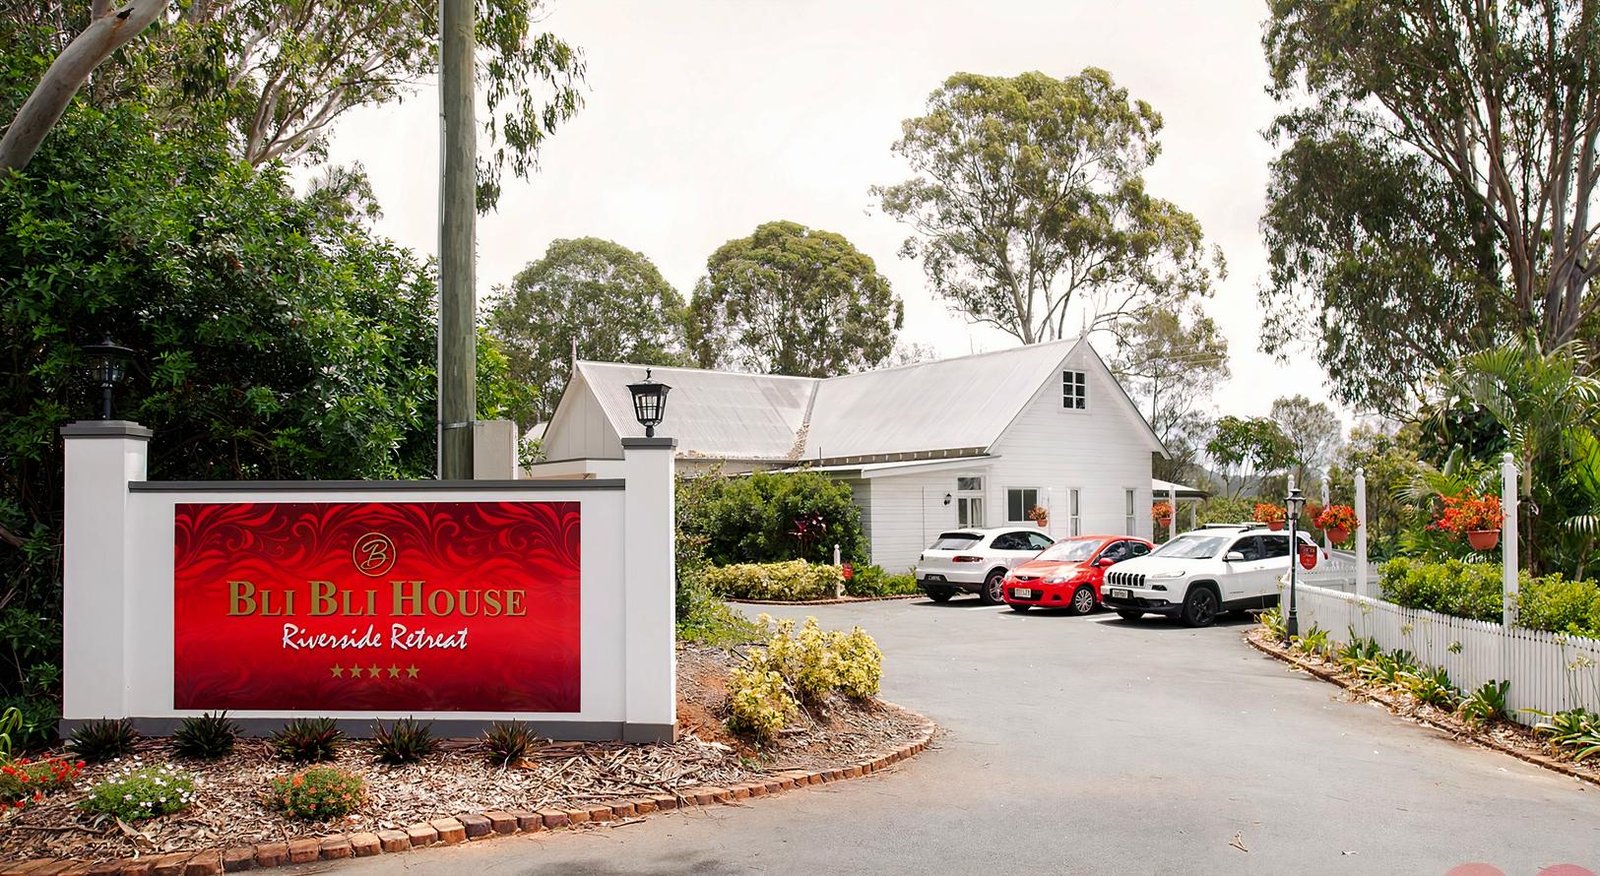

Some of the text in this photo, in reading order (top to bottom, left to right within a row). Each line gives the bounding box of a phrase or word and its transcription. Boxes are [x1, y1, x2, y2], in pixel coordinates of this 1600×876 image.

[360, 538, 390, 570] B
[226, 580, 527, 617] BLI BLI HOUSE
[282, 622, 468, 650] Riverside Retreat
